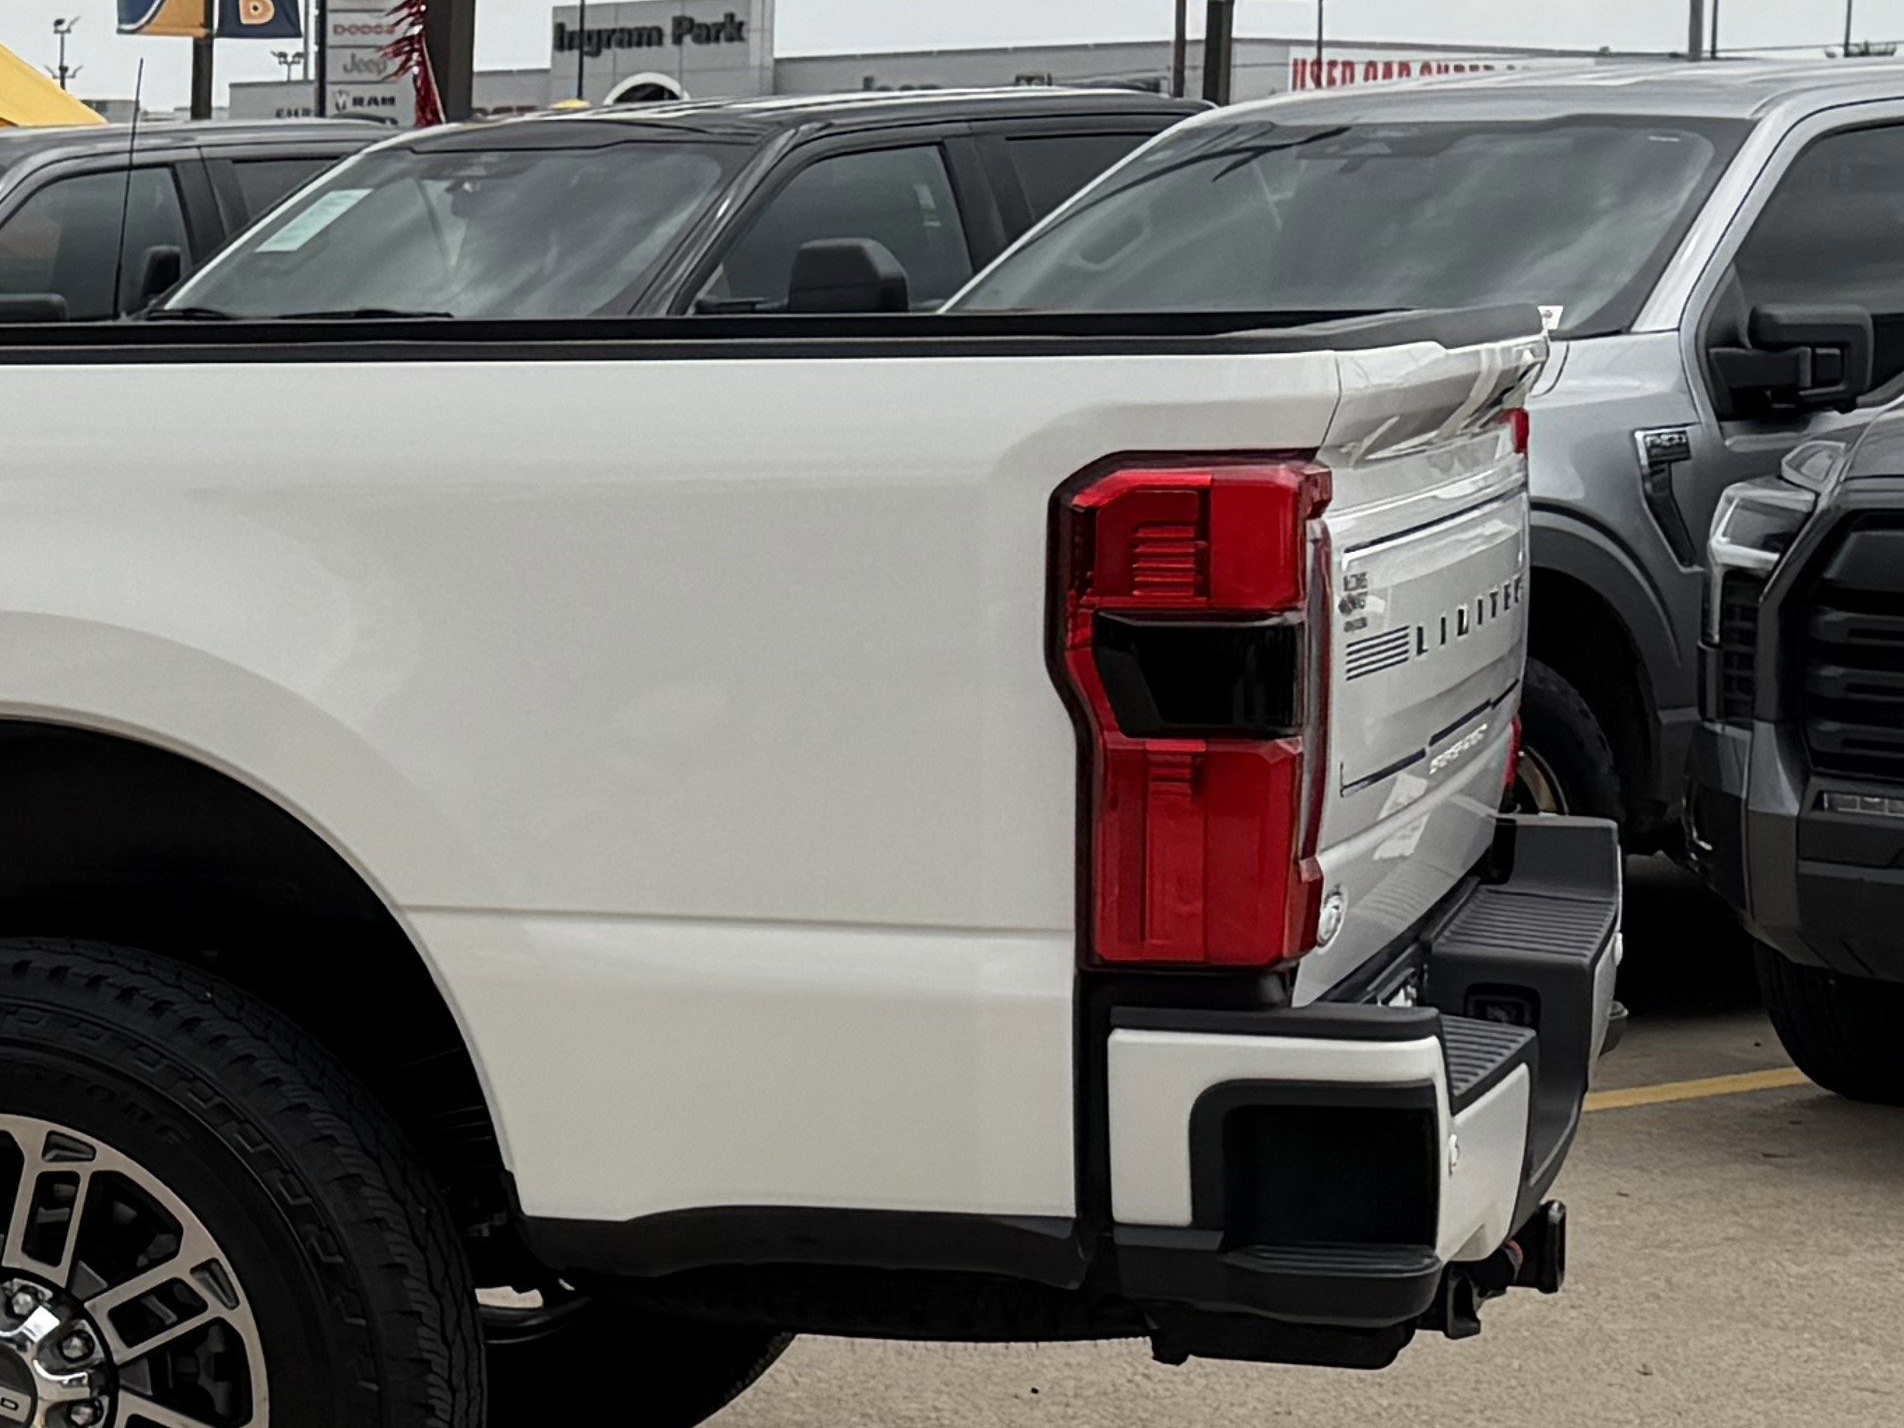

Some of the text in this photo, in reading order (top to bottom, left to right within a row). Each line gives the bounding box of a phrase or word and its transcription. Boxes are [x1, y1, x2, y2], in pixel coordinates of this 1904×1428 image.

[553, 12, 746, 58] Ingram Park
[343, 53, 388, 75] Jeep
[351, 95, 395, 107] RAM
